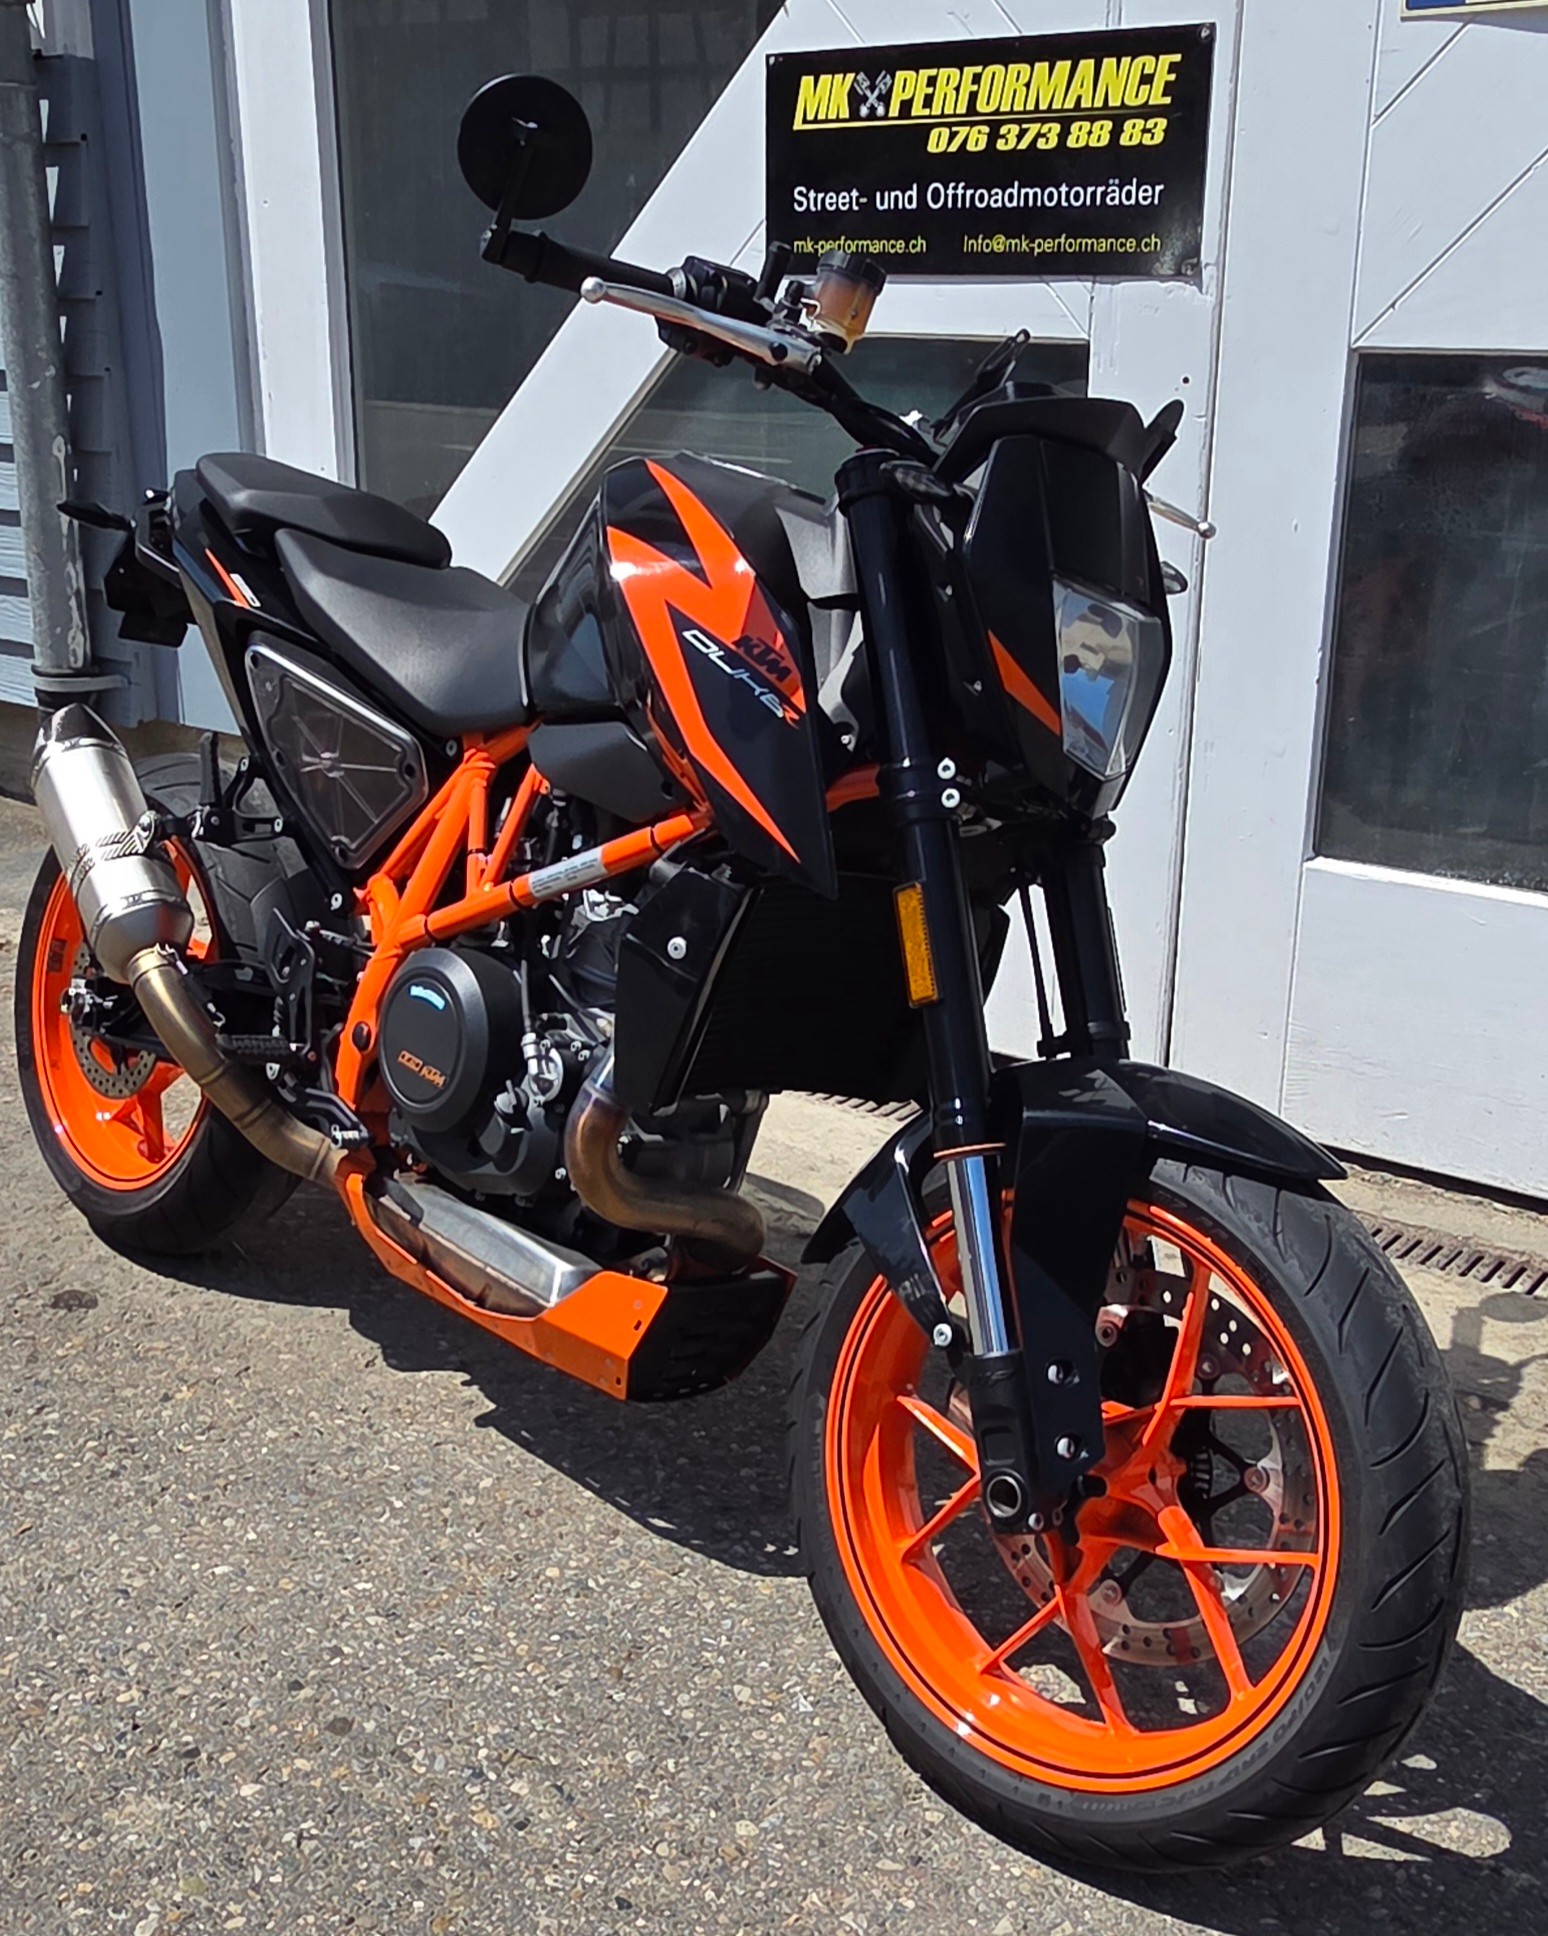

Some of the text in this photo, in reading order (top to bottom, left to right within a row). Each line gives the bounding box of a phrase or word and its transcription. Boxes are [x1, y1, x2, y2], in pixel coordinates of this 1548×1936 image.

[795, 53, 1182, 125] MK PERFORMANCE
[927, 117, 1168, 153] 076 373 88 83
[793, 177, 1165, 212] Street- und Offroadmotorräder
[793, 233, 1162, 257] mk-performance.ch Info@mk-performance.ch
[732, 634, 792, 683] KTM
